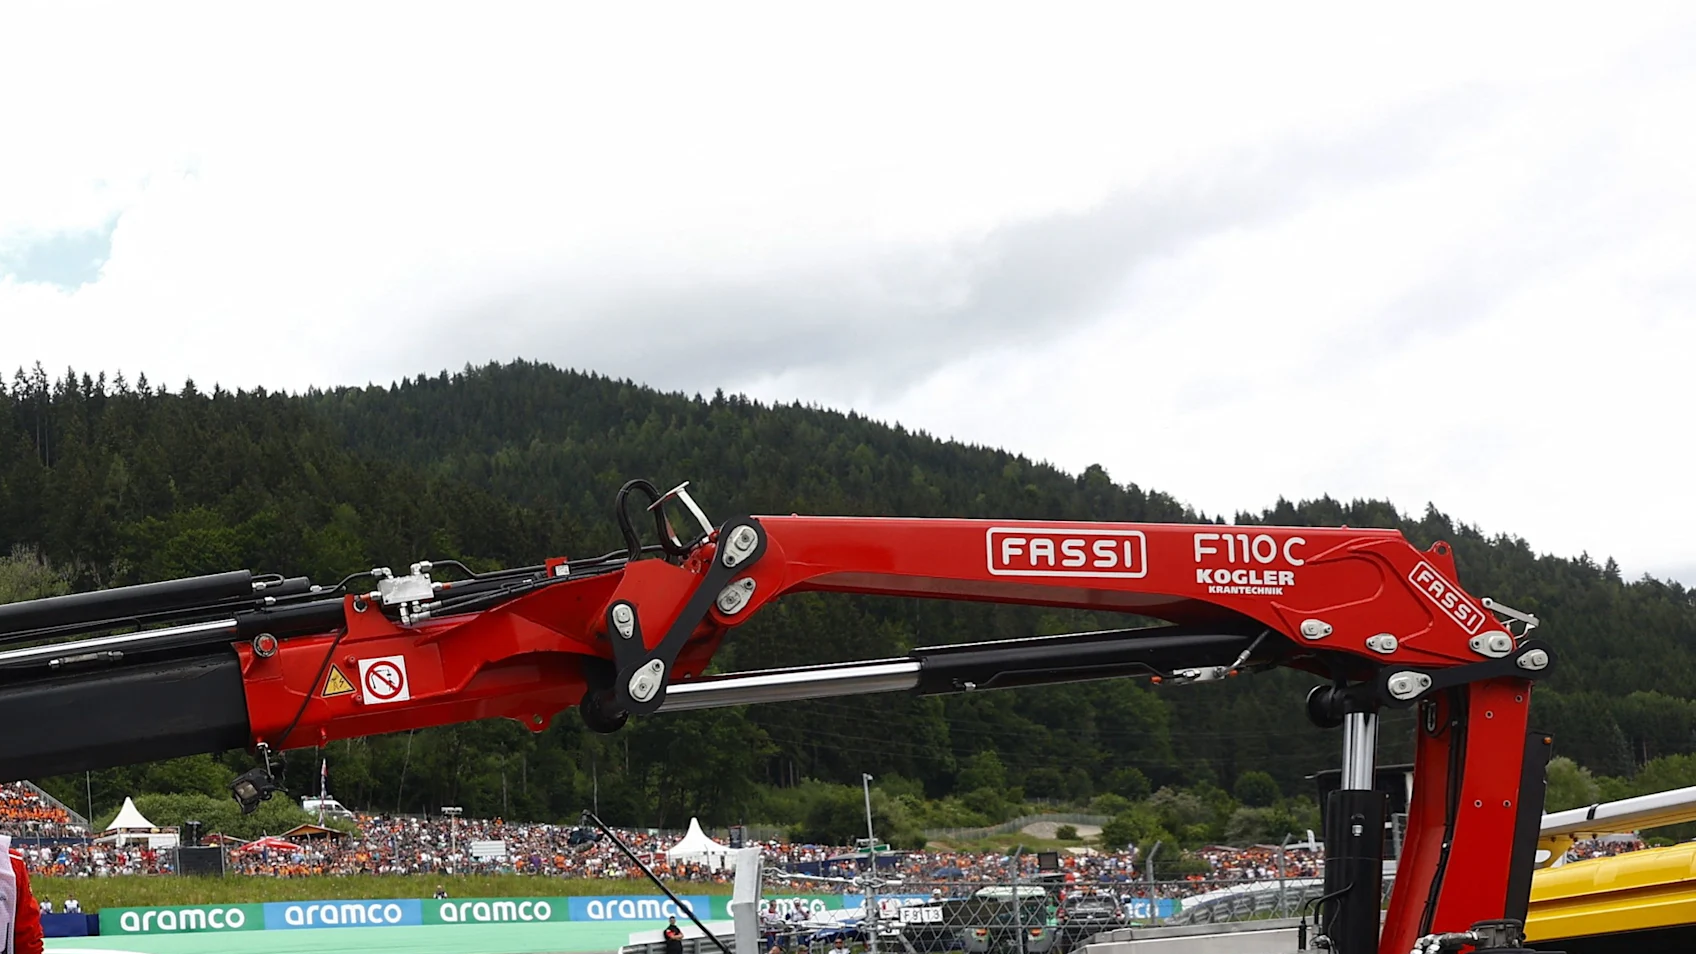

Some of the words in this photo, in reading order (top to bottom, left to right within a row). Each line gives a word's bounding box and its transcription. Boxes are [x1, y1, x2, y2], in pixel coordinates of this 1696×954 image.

[1002, 537, 1132, 569] FASSI
[1196, 568, 1295, 586] KOGLER
[1208, 585, 1283, 595] KRANTECHNIK
[1417, 567, 1477, 629] FASSI
[120, 908, 246, 931] aramco
[284, 903, 402, 926] aramco
[440, 900, 552, 923] aramco
